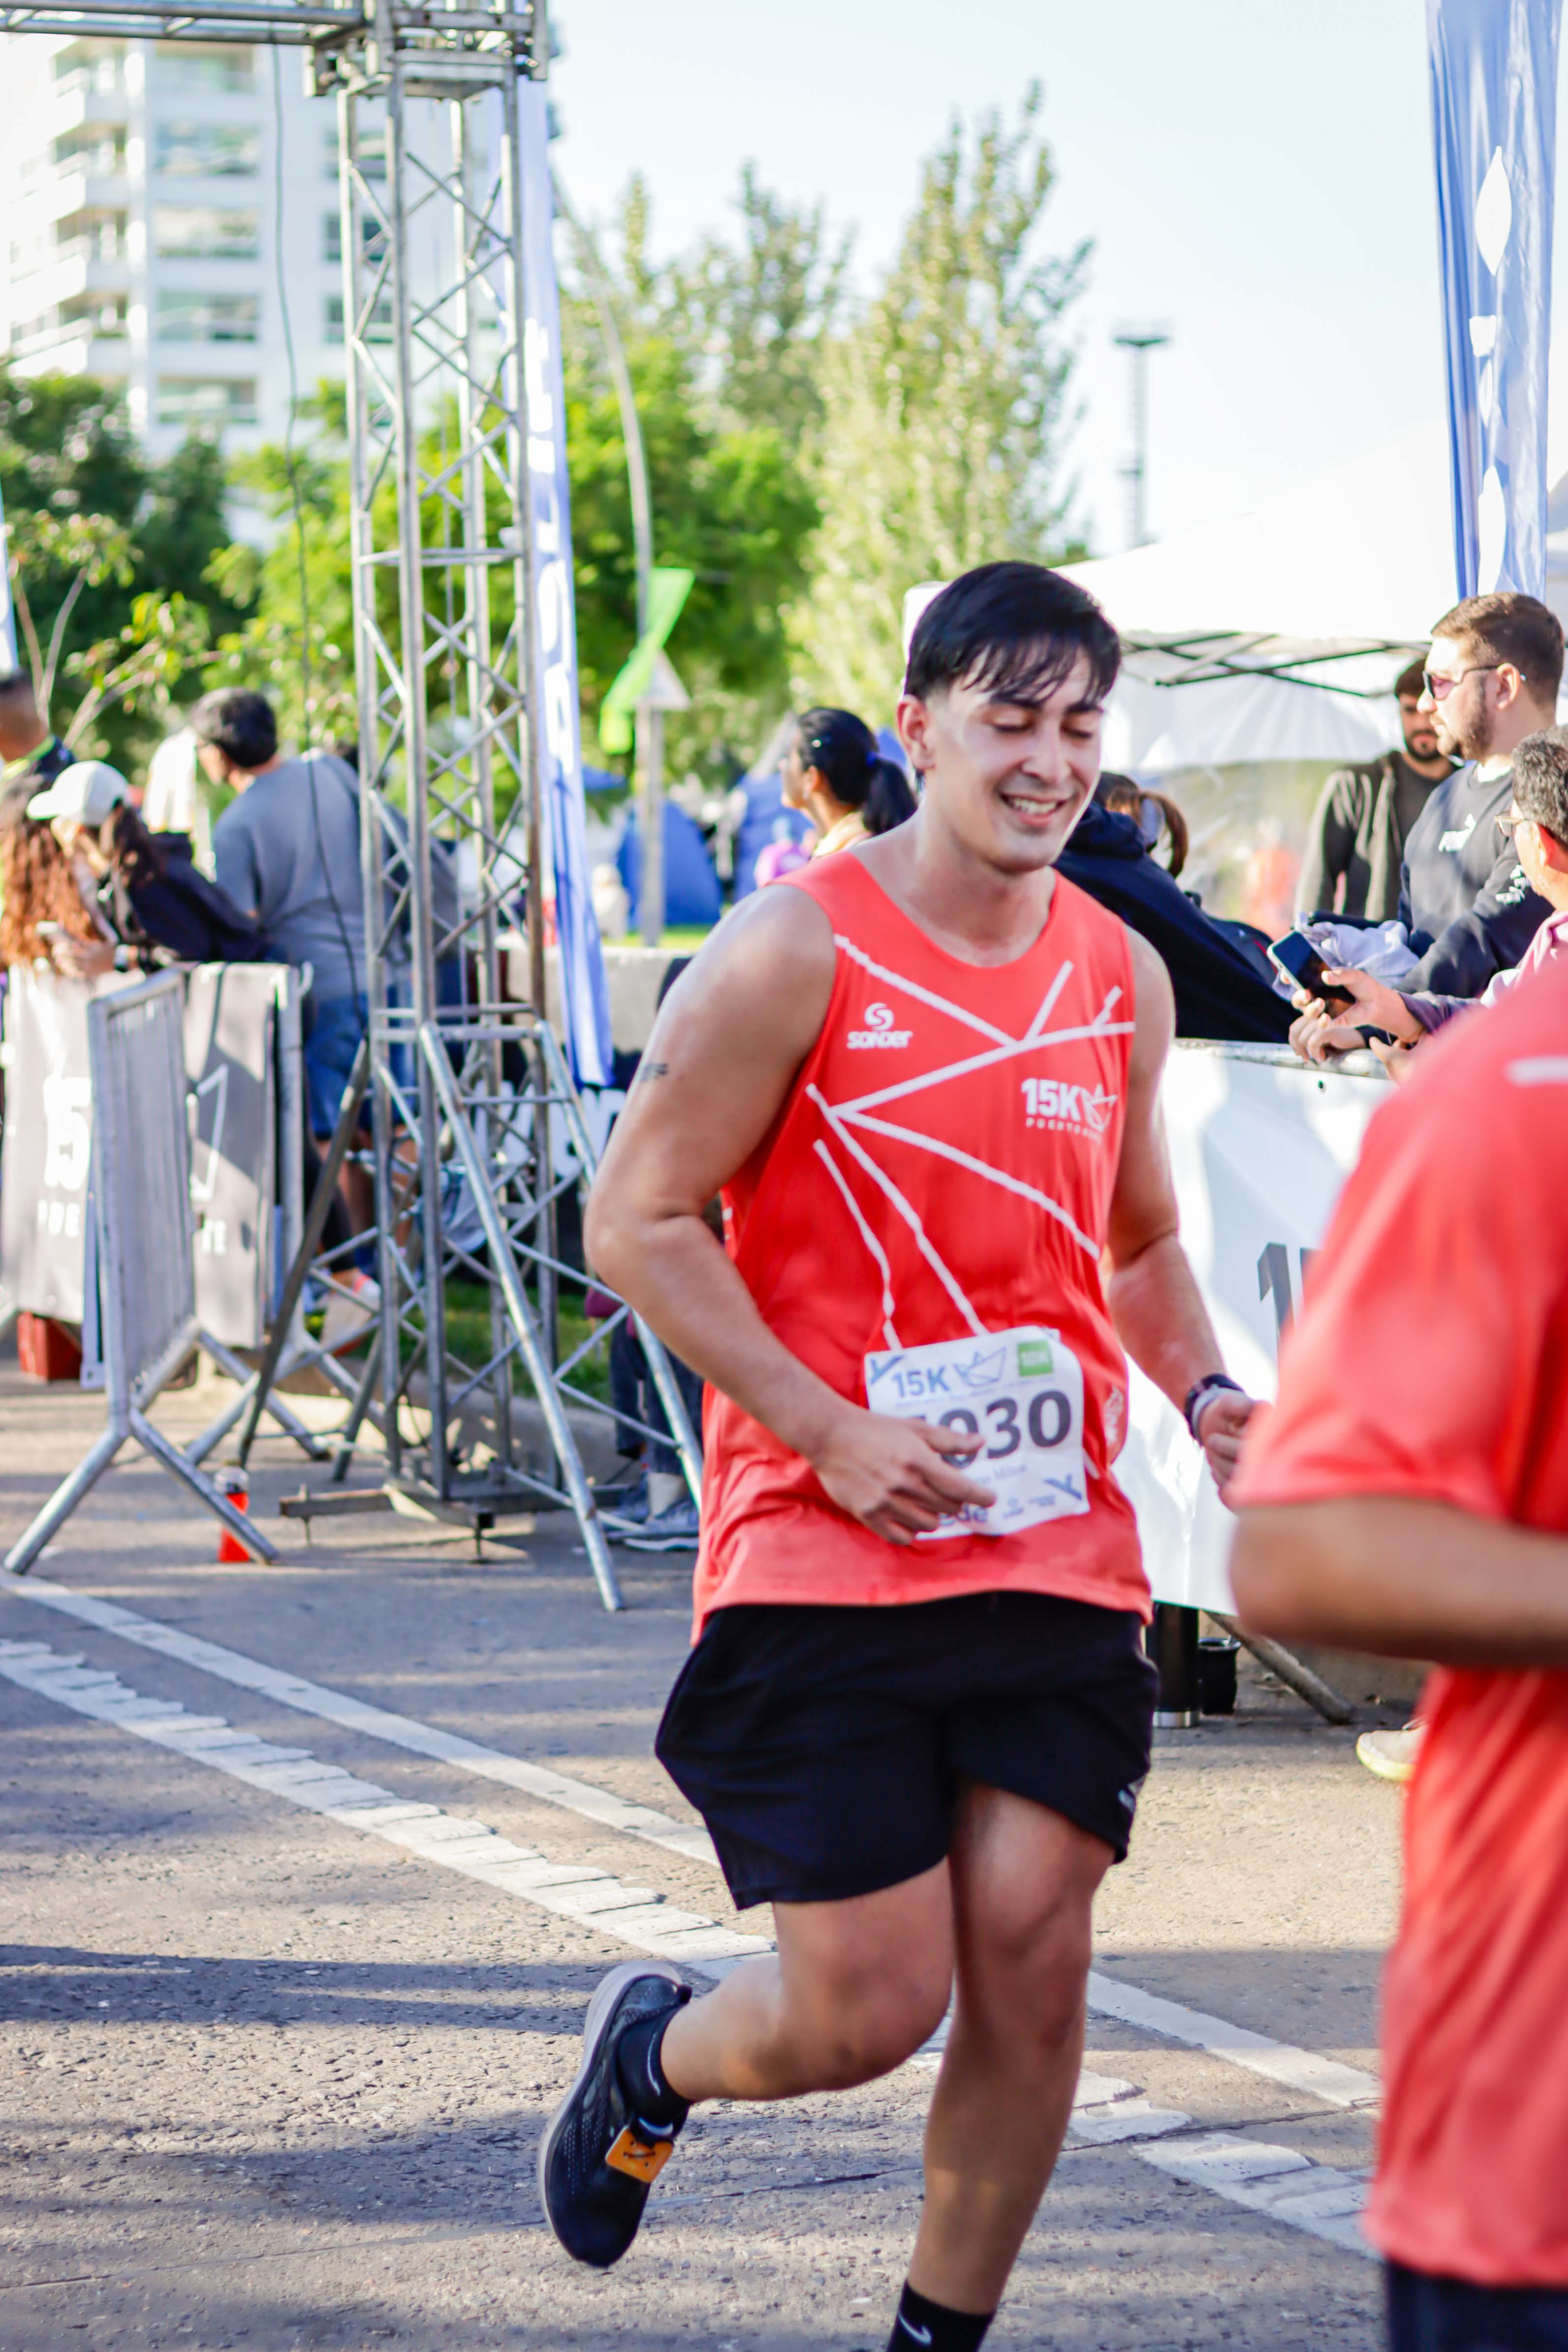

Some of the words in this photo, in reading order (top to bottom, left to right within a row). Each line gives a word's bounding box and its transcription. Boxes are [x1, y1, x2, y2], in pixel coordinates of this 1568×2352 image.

[1021, 1078, 1081, 1121] 15K
[892, 1365, 950, 1399] 15K
[905, 1390, 1071, 1469] 030
